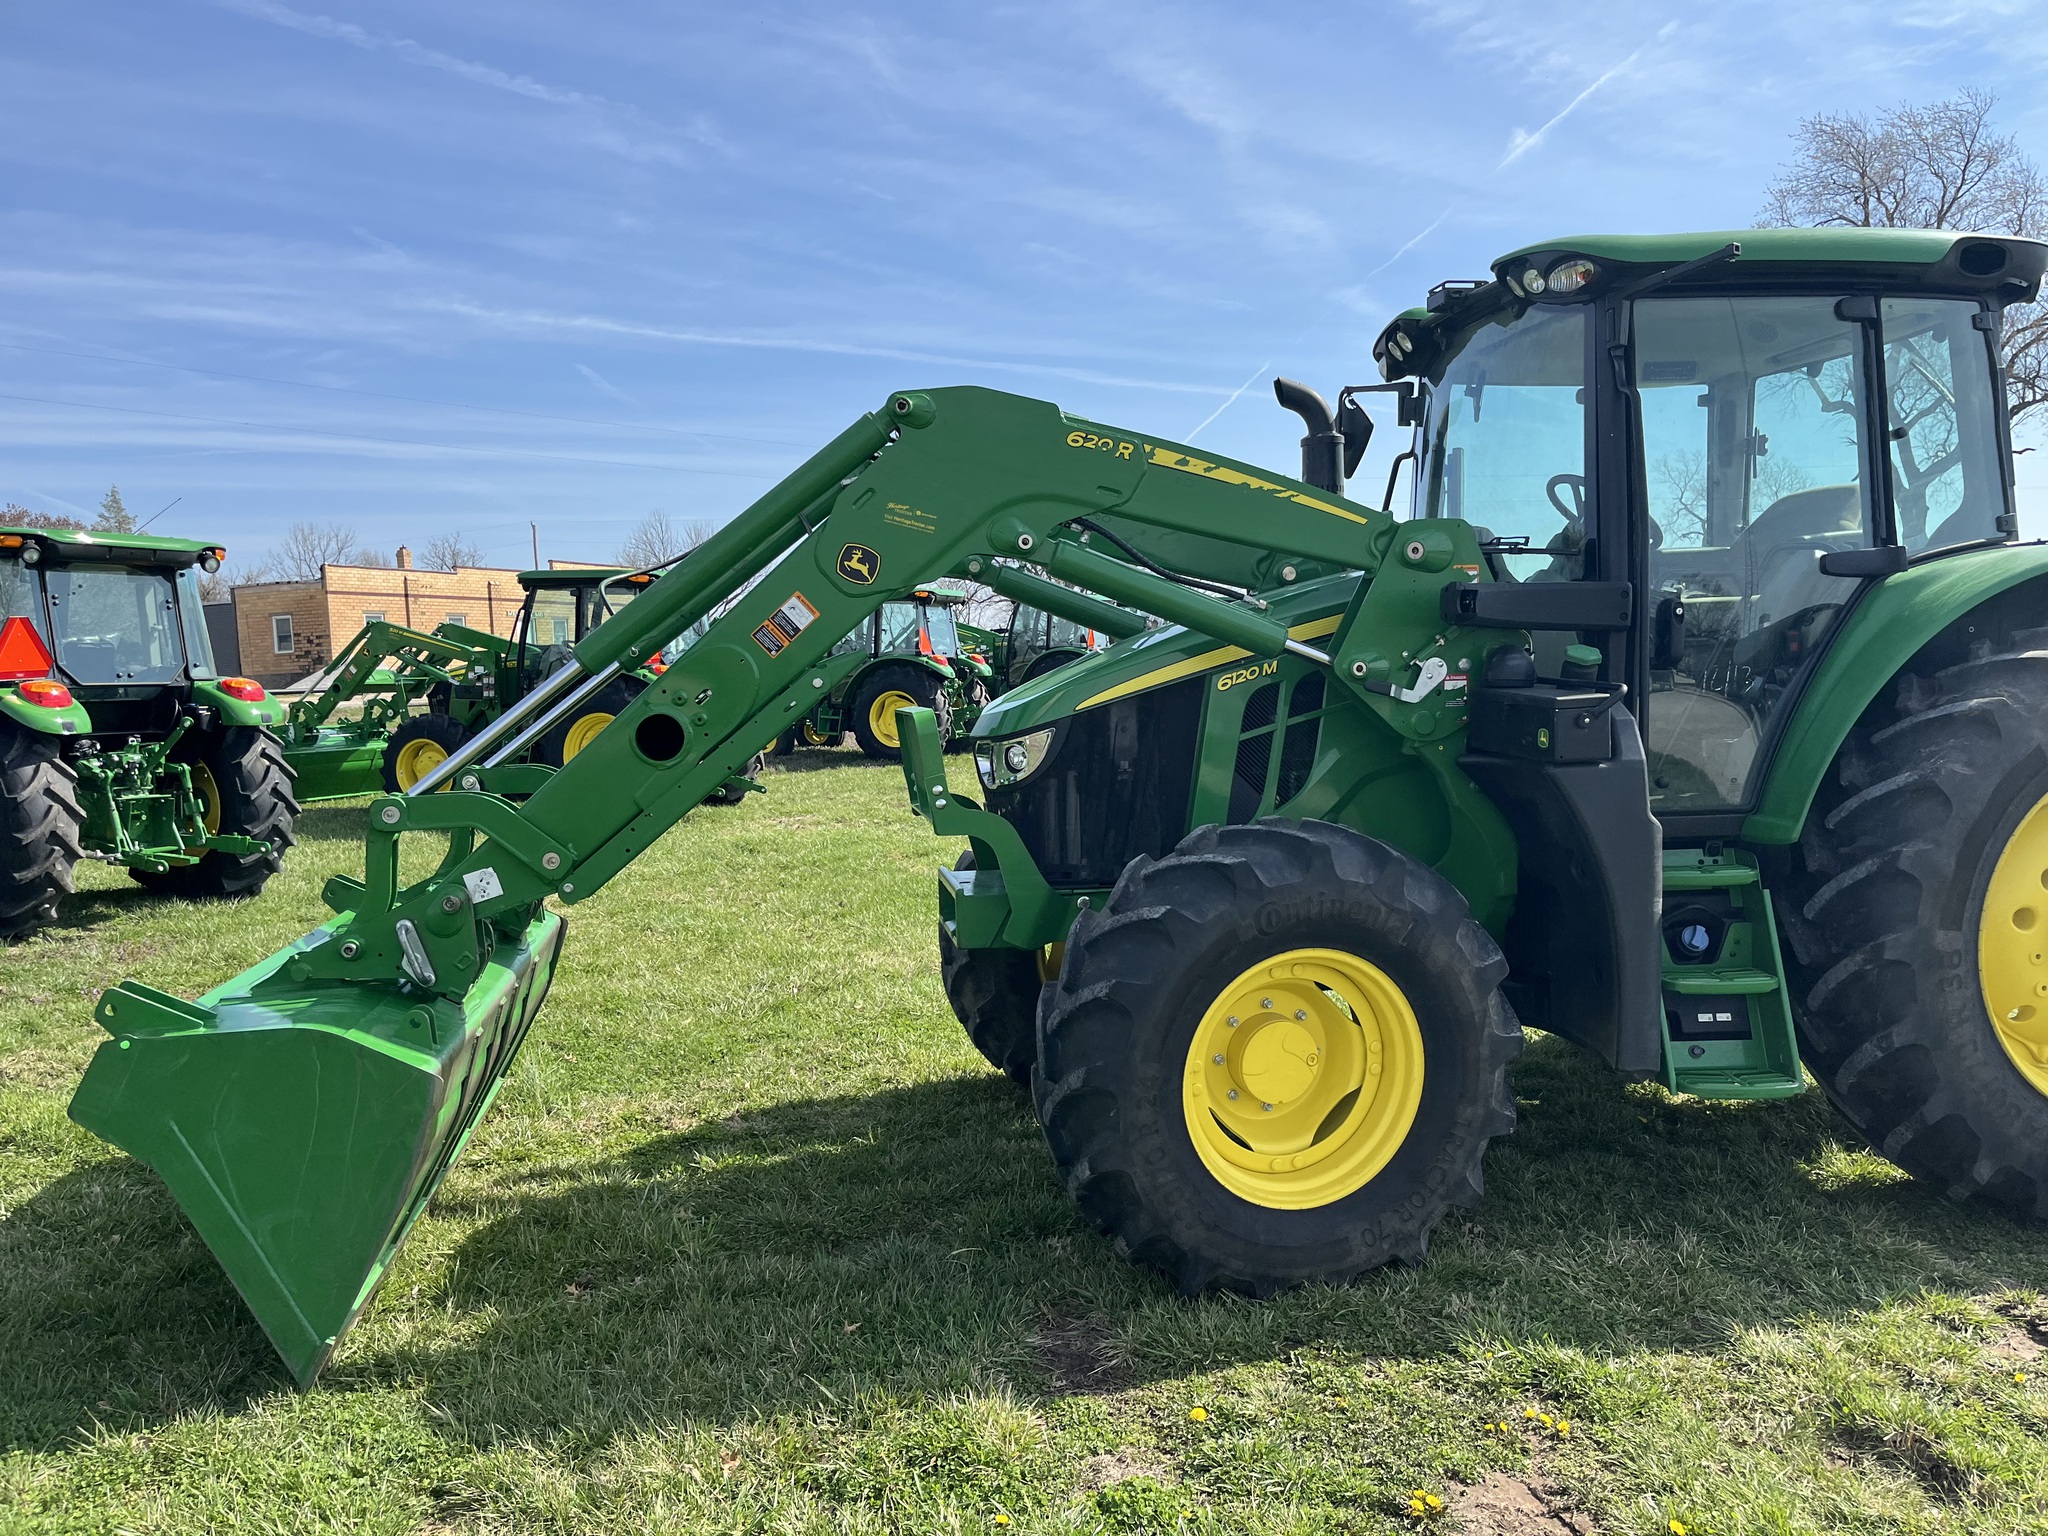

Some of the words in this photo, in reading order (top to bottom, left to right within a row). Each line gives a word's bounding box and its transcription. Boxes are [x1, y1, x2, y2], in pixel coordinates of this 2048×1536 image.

[1066, 431, 1114, 452] 620
[1114, 441, 1135, 461] R
[1217, 666, 1260, 691] 6120
[1262, 659, 1279, 676] M
[1392, 1118, 1472, 1223] TRACTOR
[1360, 1219, 1391, 1248] 70
